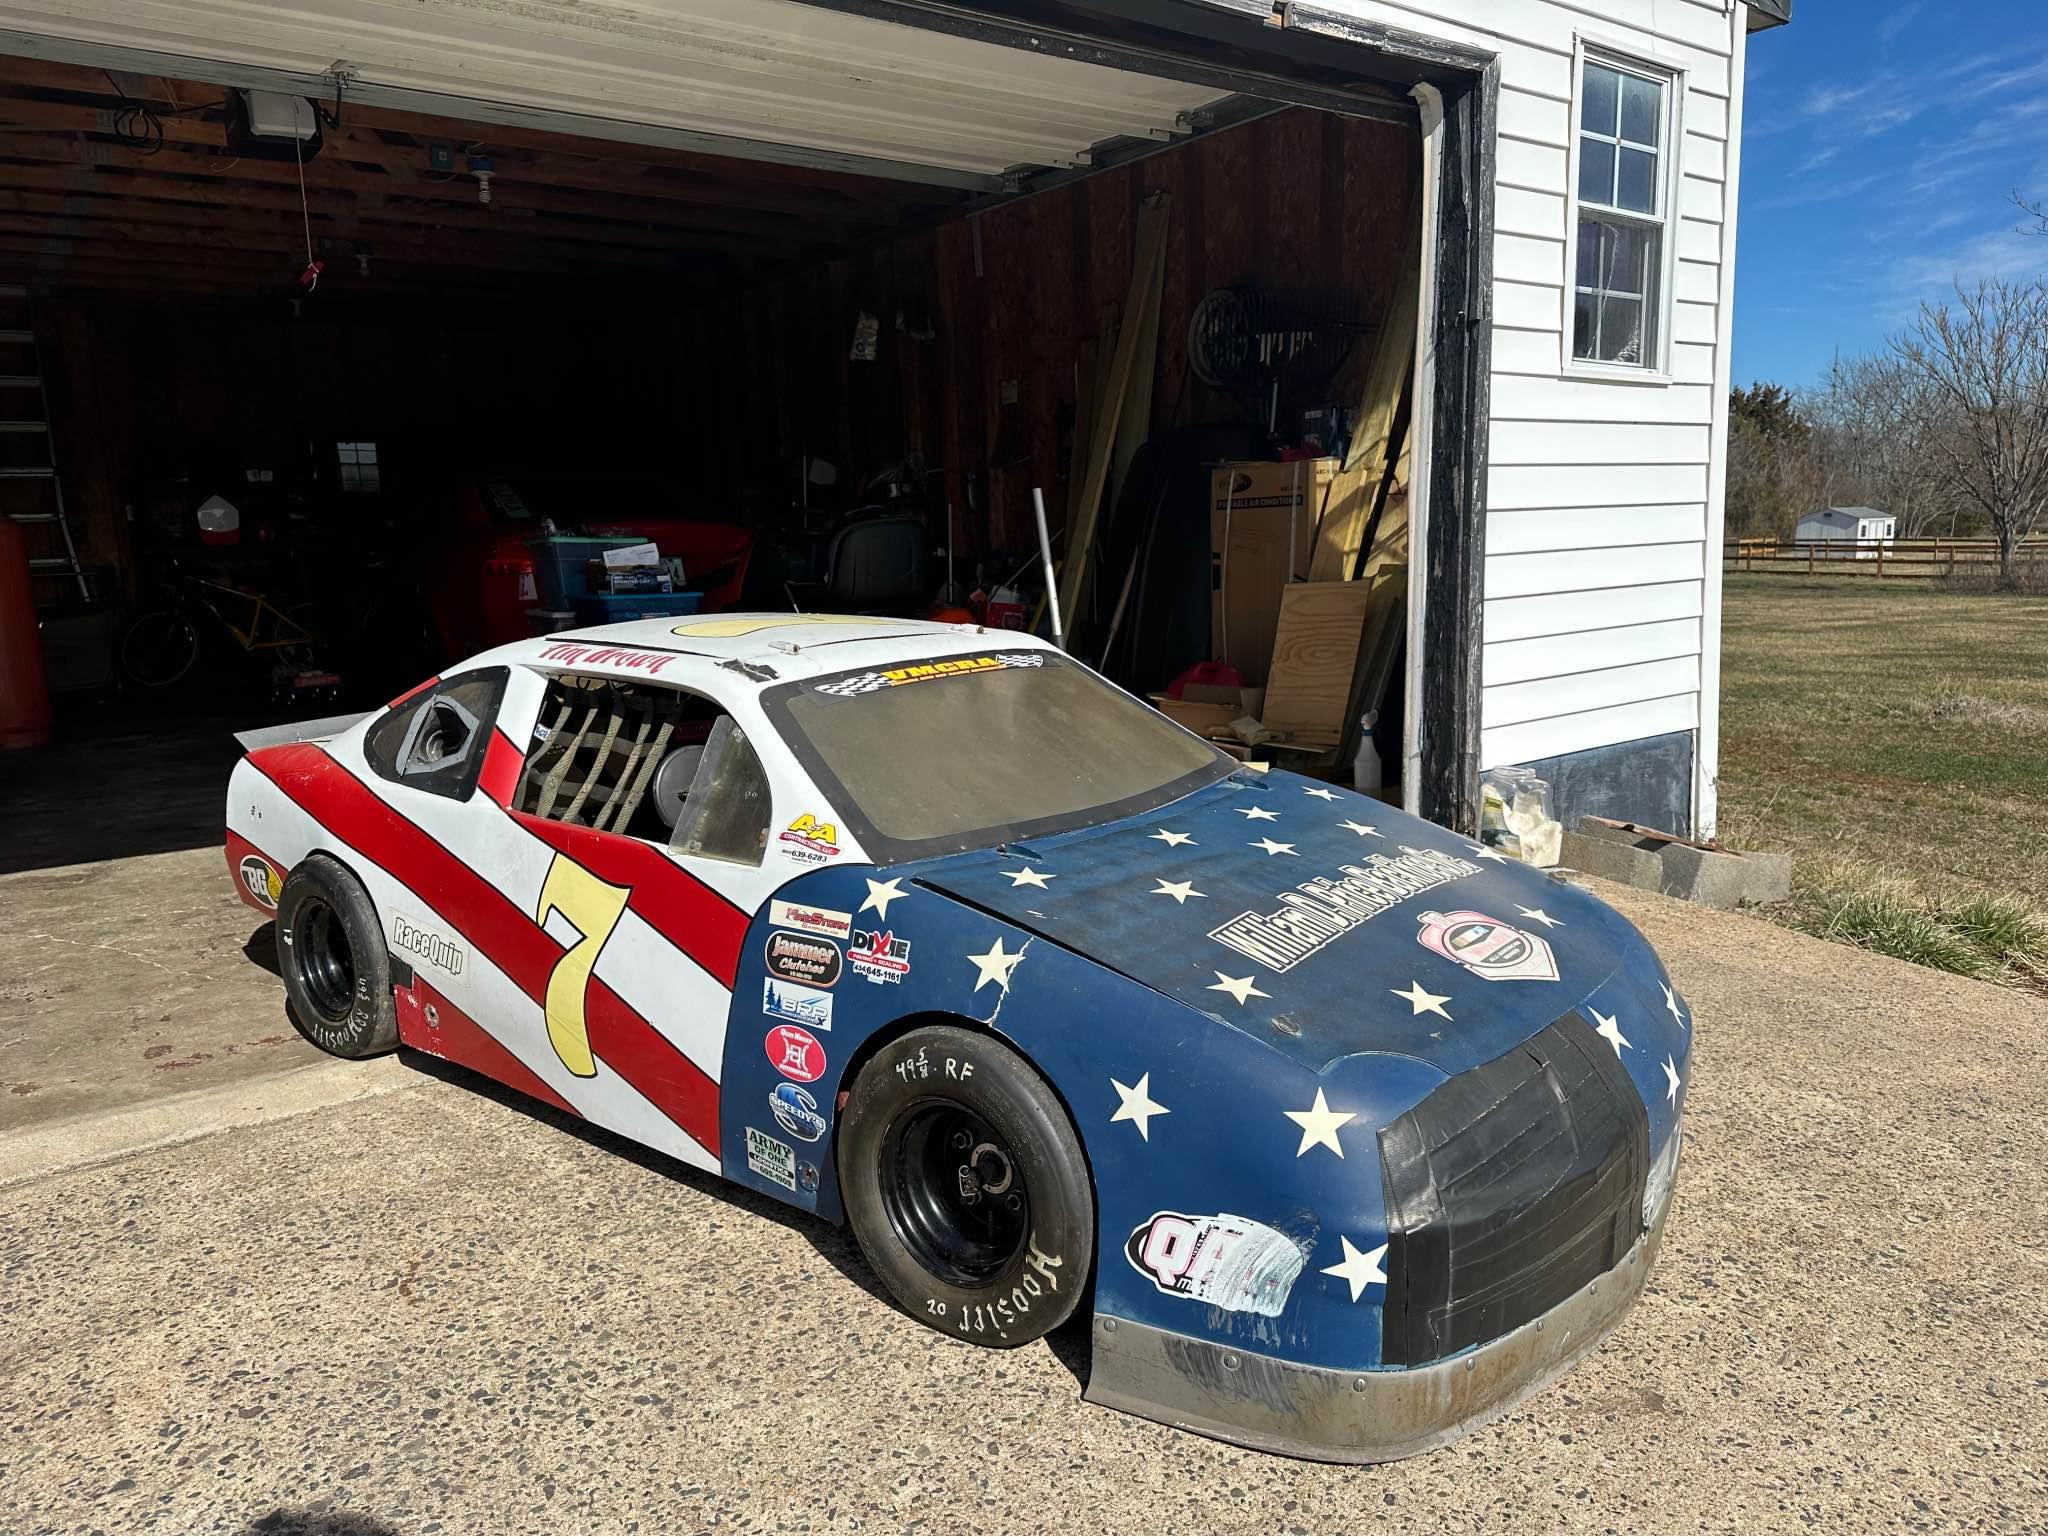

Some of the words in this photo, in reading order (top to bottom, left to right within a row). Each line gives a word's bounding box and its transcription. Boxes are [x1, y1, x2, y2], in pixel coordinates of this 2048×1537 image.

[1218, 498, 1248, 509] PORABLE
[1260, 495, 1302, 506] CONDITIONR
[881, 657, 998, 682] VMCRA
[246, 866, 268, 896] BG
[394, 917, 463, 975] RaceQuip
[771, 935, 836, 964] Jammer
[852, 931, 909, 959] DIXIE
[1209, 908, 1341, 971] William
[535, 850, 635, 1079] 7
[878, 960, 903, 970] SEALING
[783, 997, 829, 1018] BRP
[769, 1093, 824, 1130] SPEEDY'S
[749, 1130, 792, 1158] ARMY
[754, 1145, 766, 1156] OF
[768, 1151, 788, 1167] ONE
